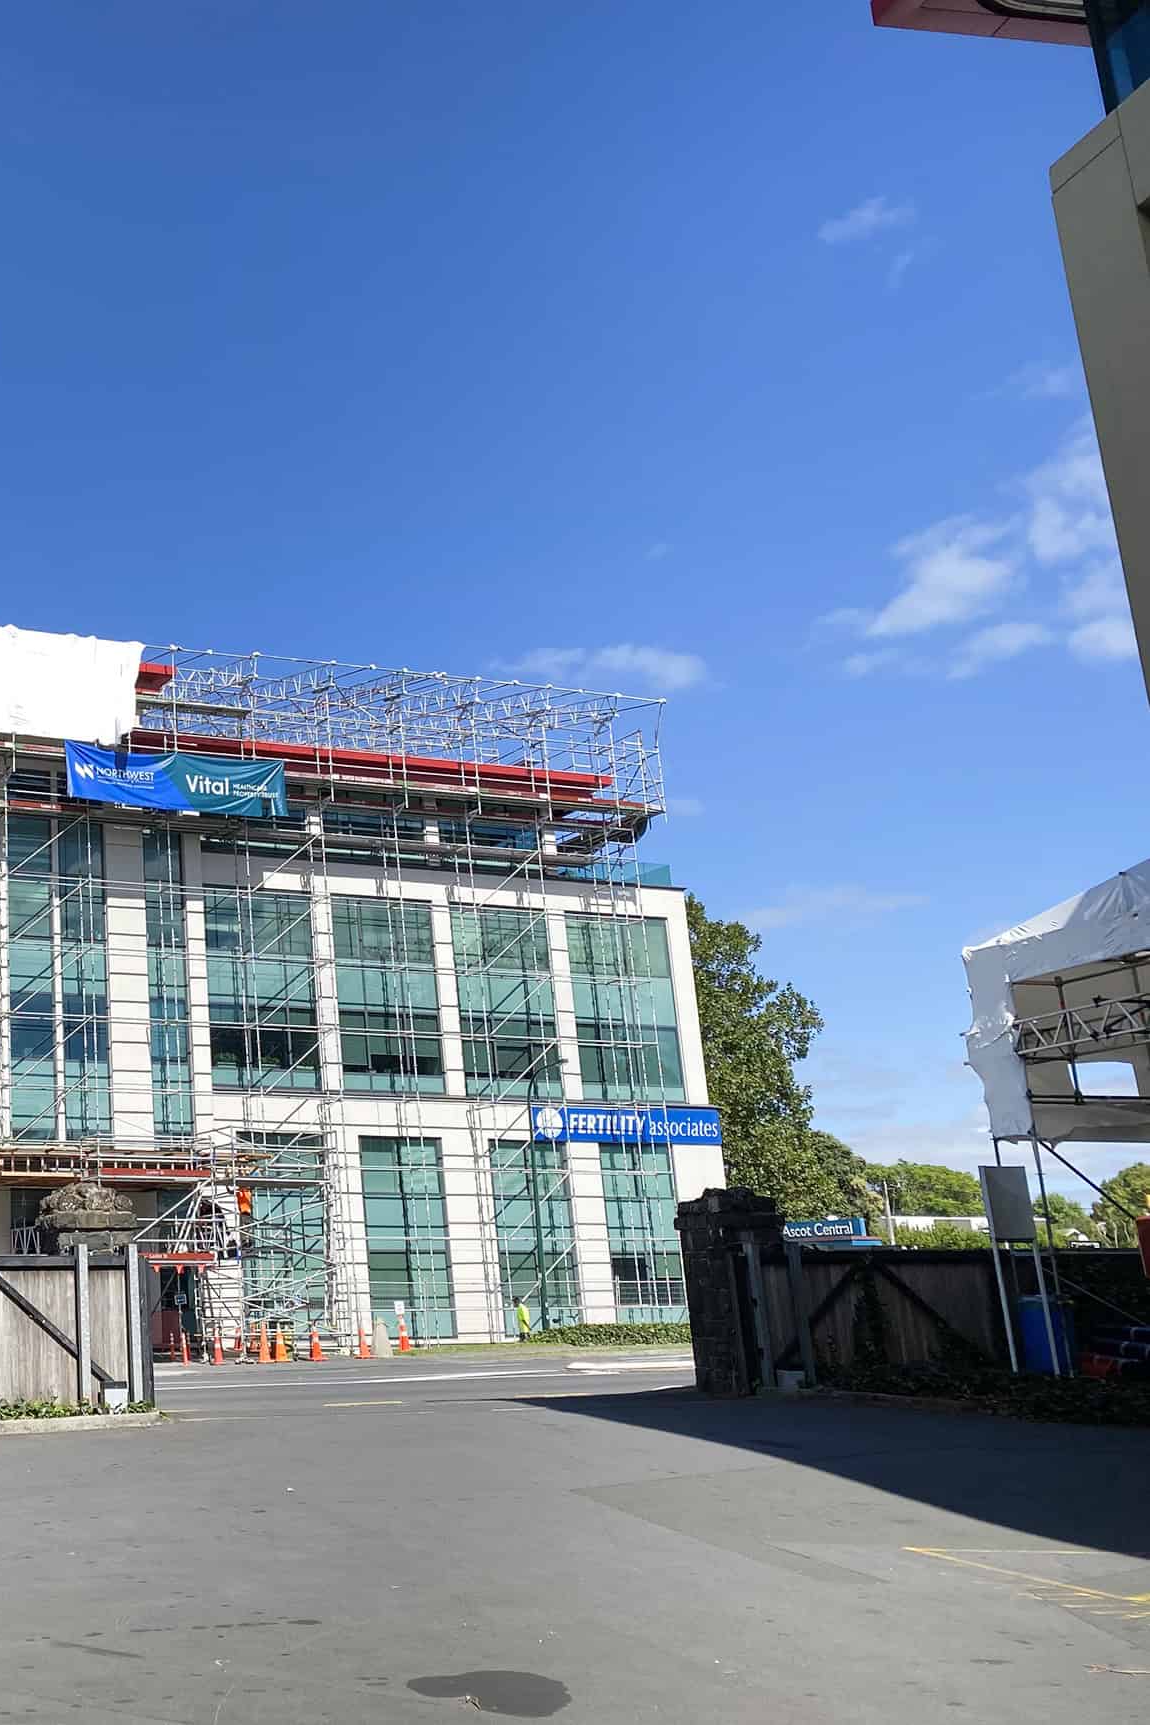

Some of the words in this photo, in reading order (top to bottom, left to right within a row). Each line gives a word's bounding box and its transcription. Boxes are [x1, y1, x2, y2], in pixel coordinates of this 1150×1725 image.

[96, 767, 154, 781] NORTHWEST
[185, 775, 229, 796] Vital
[570, 1114, 644, 1135] FERTILITY
[650, 1118, 717, 1137] associates
[783, 1225, 812, 1238] Ascot
[814, 1221, 853, 1236] Central
